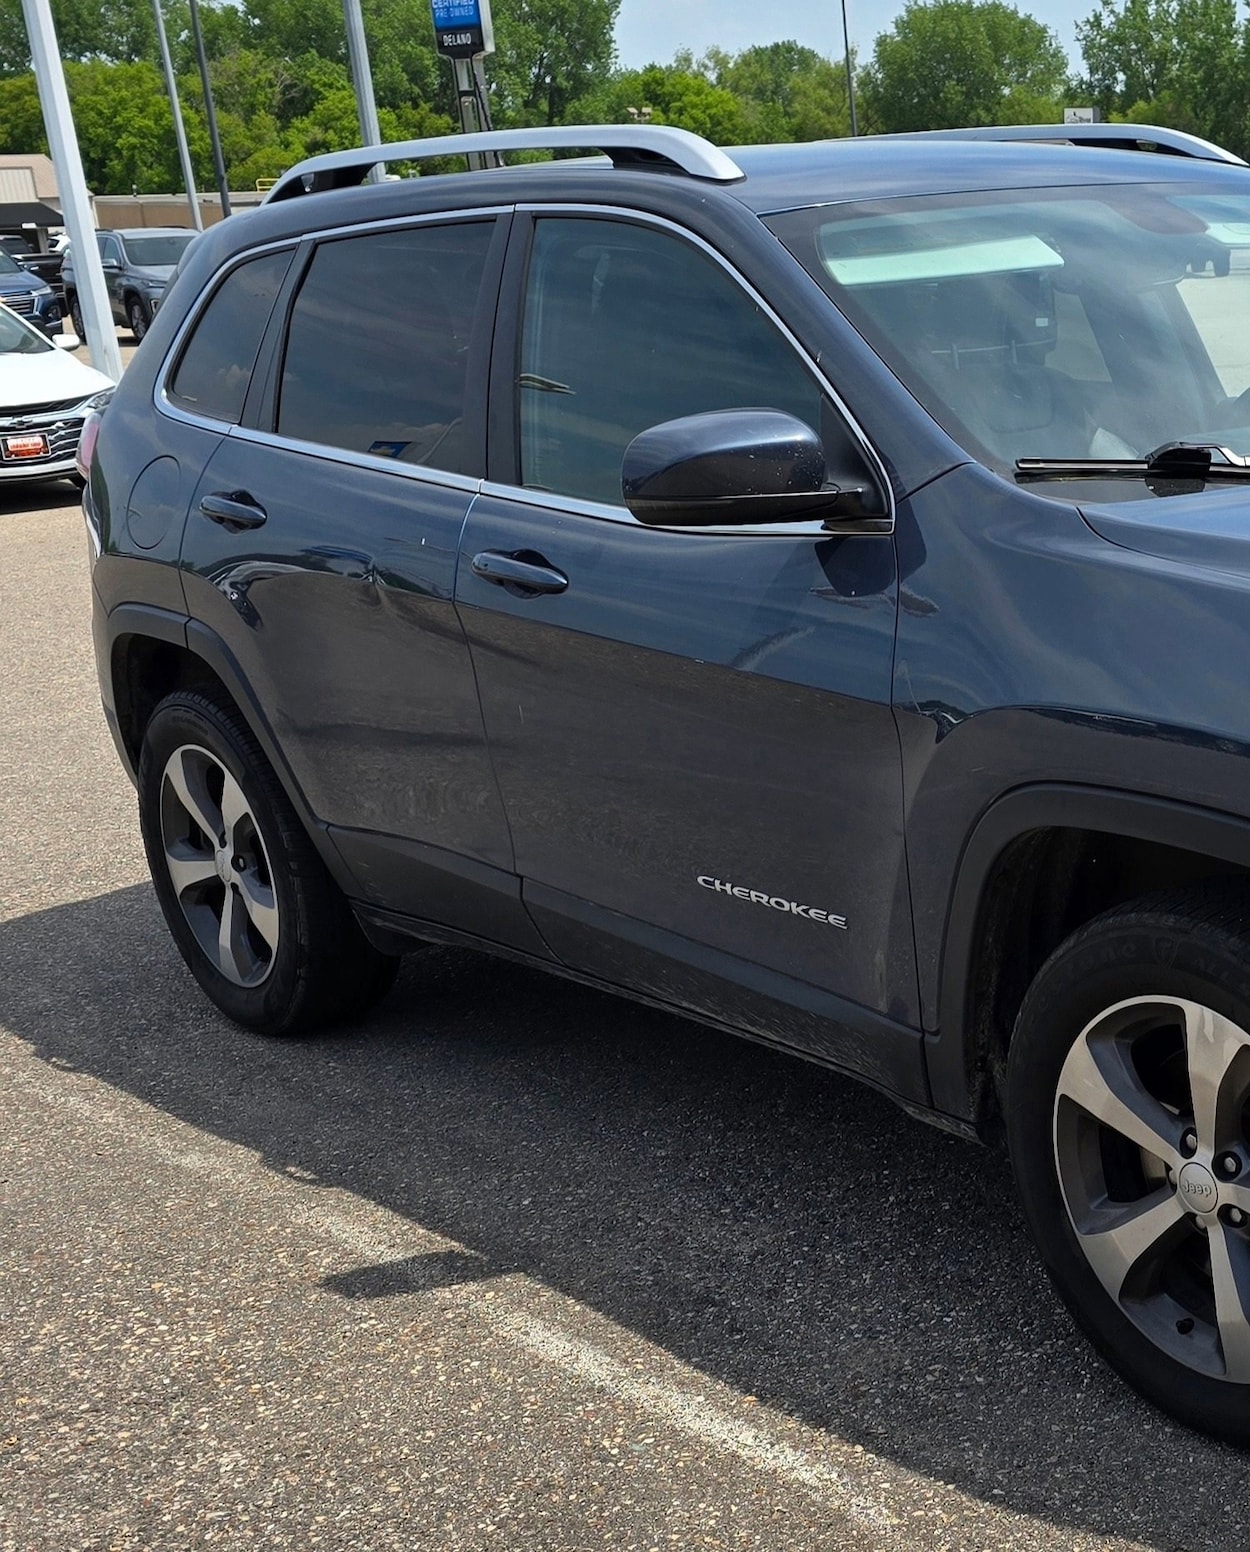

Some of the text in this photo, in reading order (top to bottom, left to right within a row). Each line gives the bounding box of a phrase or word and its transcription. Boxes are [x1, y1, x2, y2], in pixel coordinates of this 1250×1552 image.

[442, 33, 472, 46] DELANO
[697, 875, 848, 930] CHEROKEE
[1182, 1179, 1212, 1198] Jeep
